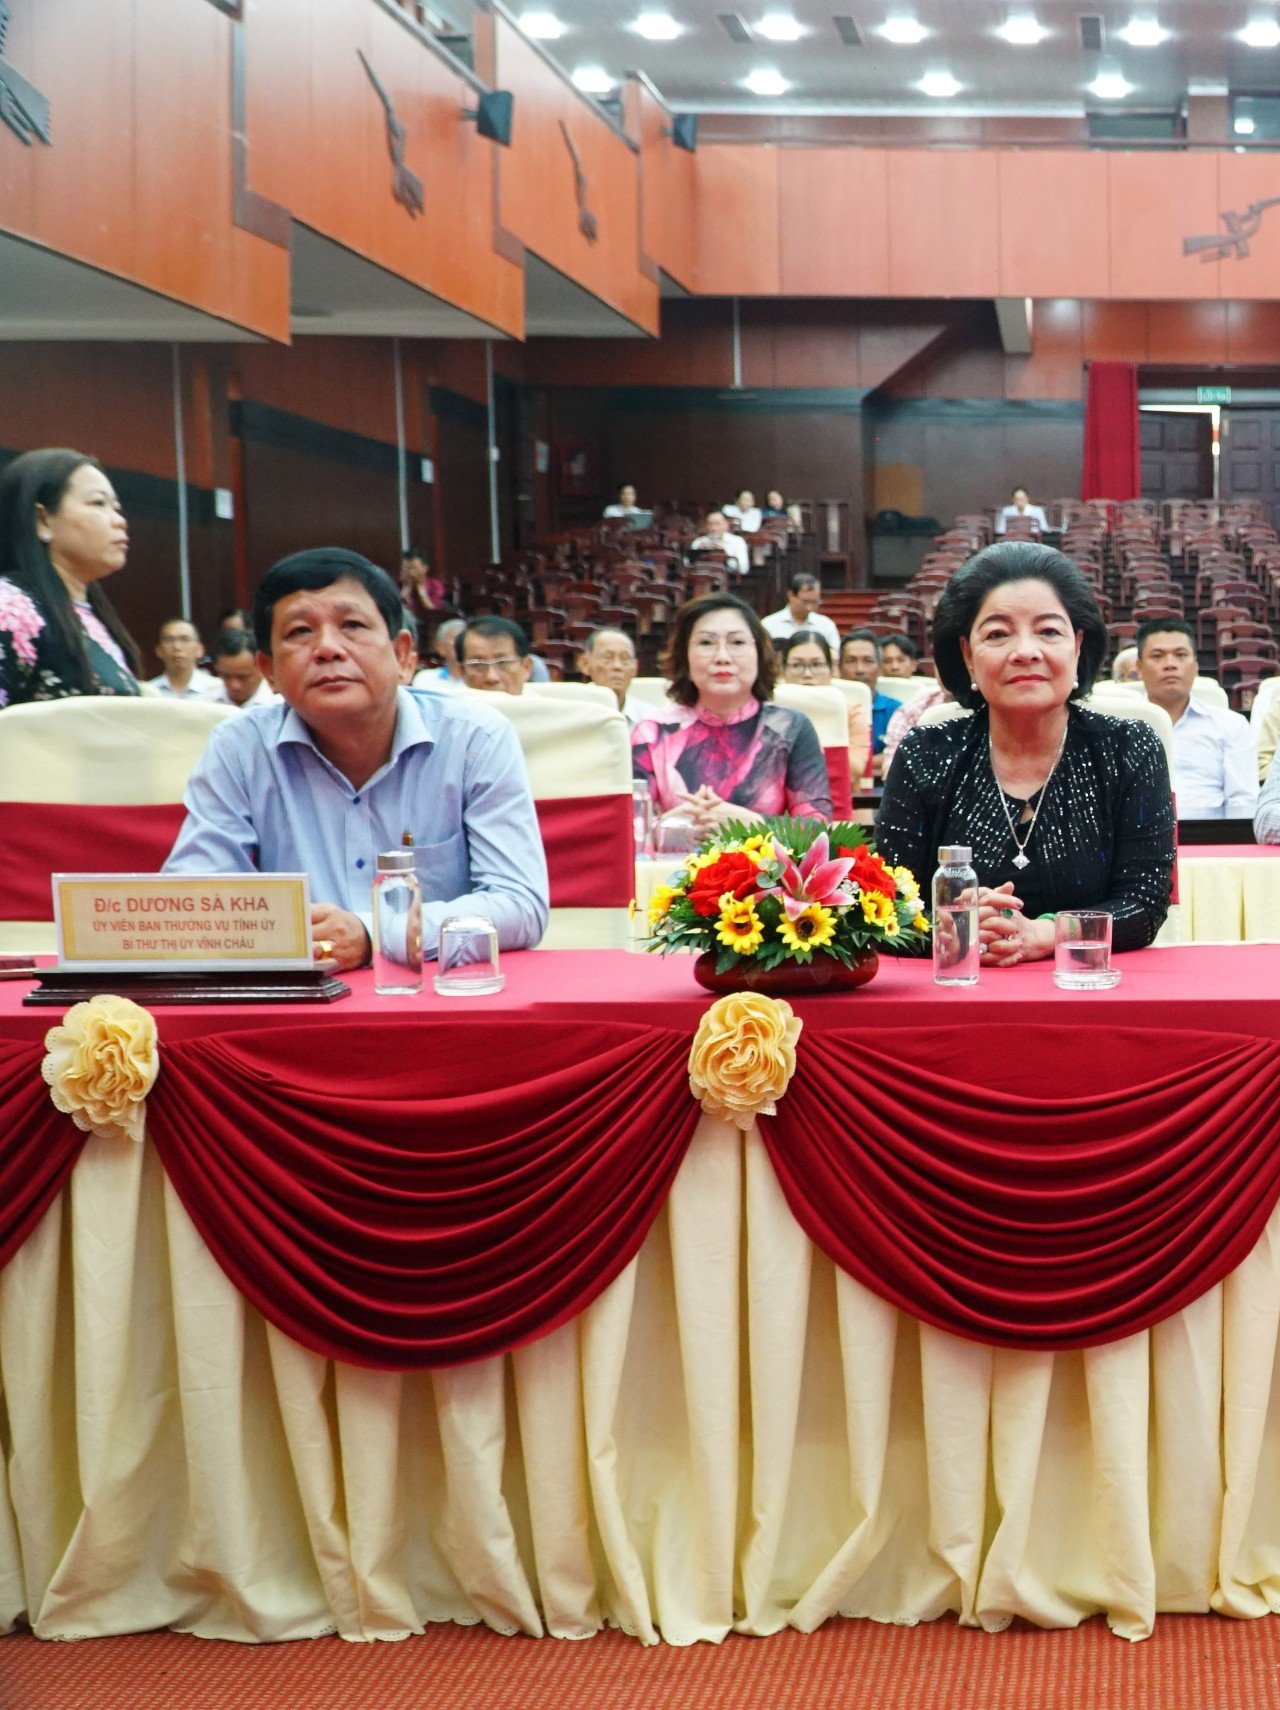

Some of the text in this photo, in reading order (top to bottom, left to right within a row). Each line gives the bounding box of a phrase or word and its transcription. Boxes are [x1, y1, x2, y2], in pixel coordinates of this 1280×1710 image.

[94, 897, 122, 912] Đ/c
[127, 897, 195, 912] DƯƠNG
[230, 897, 269, 911] KHA
[139, 920, 161, 932] BAN
